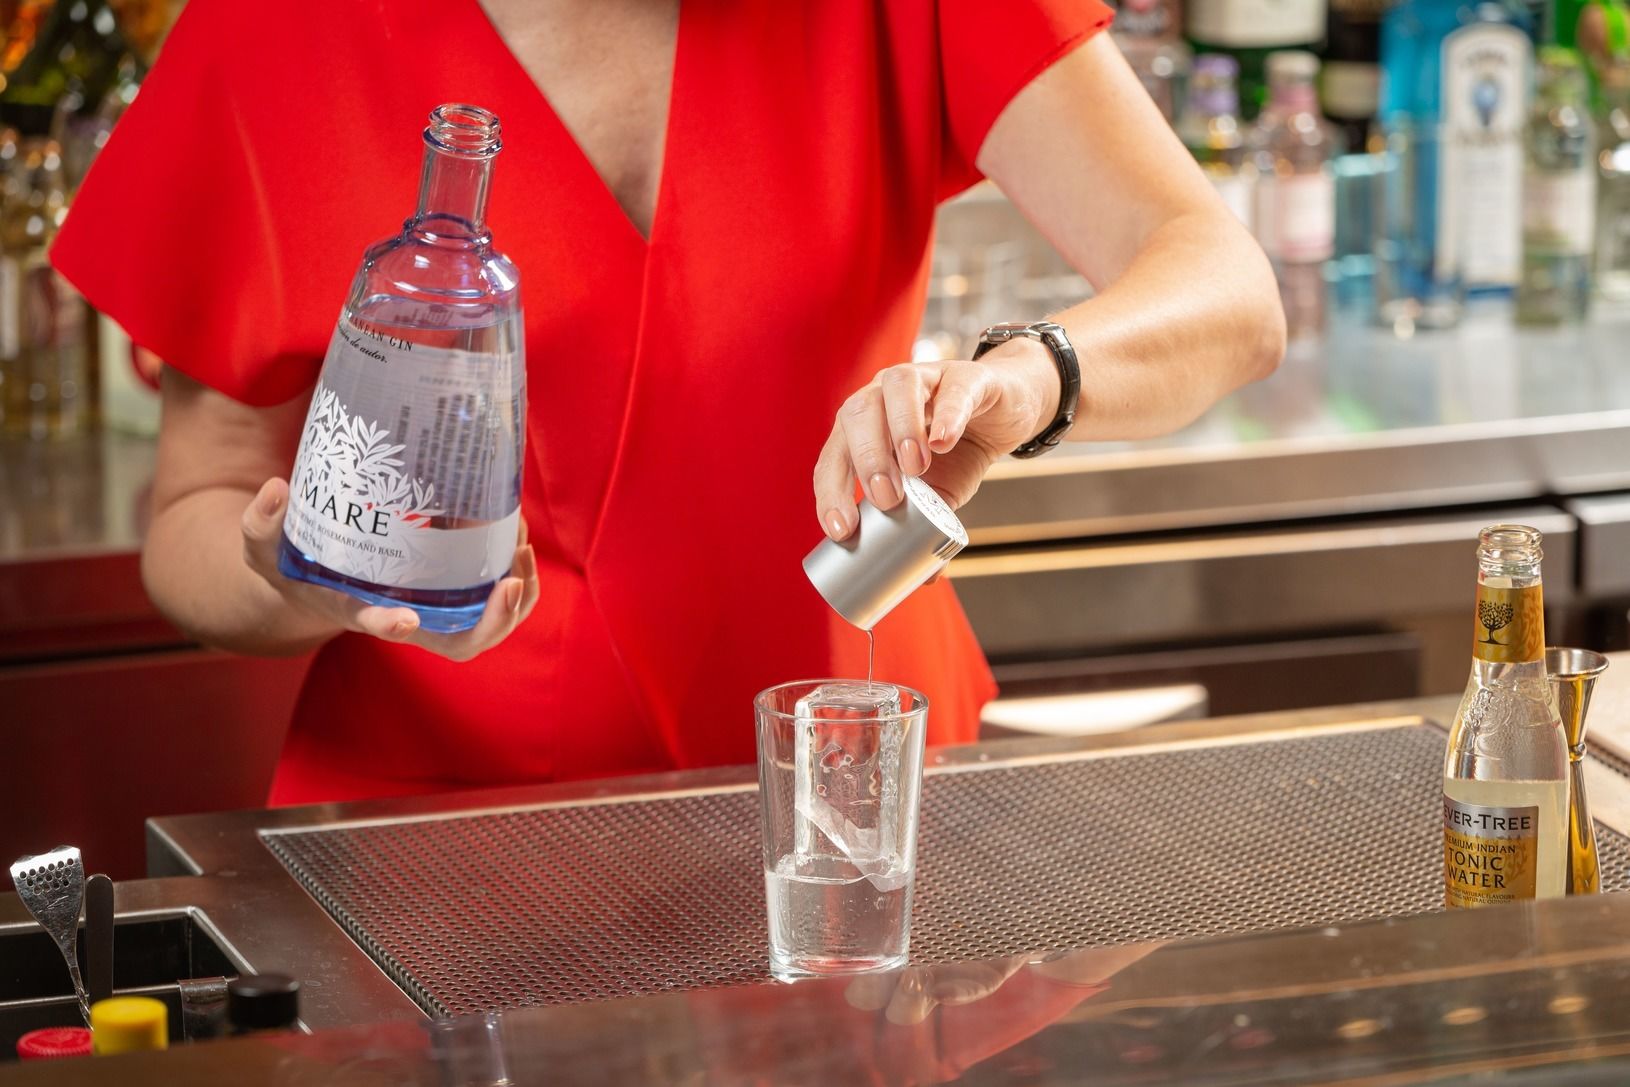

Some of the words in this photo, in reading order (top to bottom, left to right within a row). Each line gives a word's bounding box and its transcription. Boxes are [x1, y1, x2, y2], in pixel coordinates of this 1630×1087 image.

[350, 338, 361, 348] de
[389, 336, 413, 352] GIN
[300, 477, 391, 537] MARE
[318, 523, 358, 548] ROSEMARY
[358, 541, 376, 553] AND
[1444, 804, 1531, 831] EVER-TREE
[1477, 843, 1516, 854] INDIAN
[1448, 847, 1503, 871] TONIC
[1448, 863, 1506, 888] WATER
[1462, 890, 1486, 899] NATURAL
[1463, 896, 1486, 904] NATURAL
